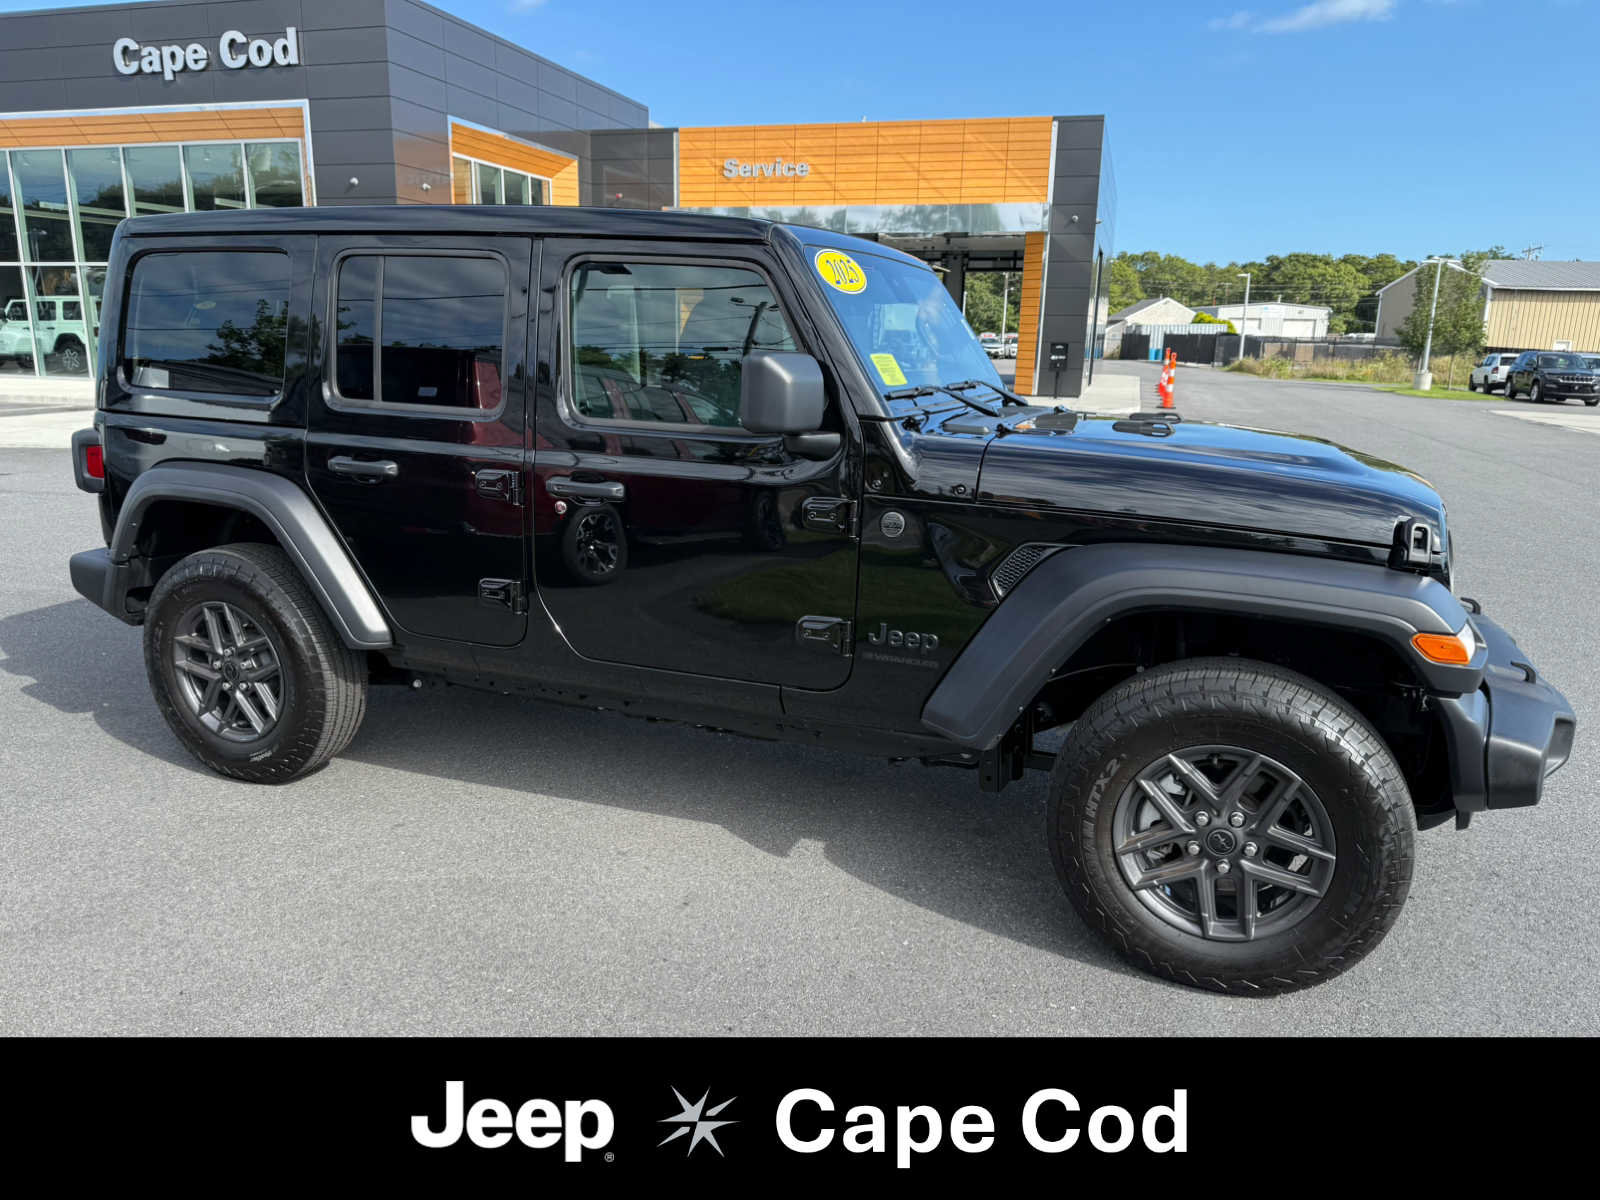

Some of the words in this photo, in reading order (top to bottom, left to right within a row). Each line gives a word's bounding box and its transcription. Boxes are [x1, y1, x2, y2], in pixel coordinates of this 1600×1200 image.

[113, 37, 209, 81] Cape
[219, 26, 299, 69] Cod
[722, 157, 809, 178] Service
[825, 258, 861, 285] 2025
[867, 622, 939, 656] Jeep
